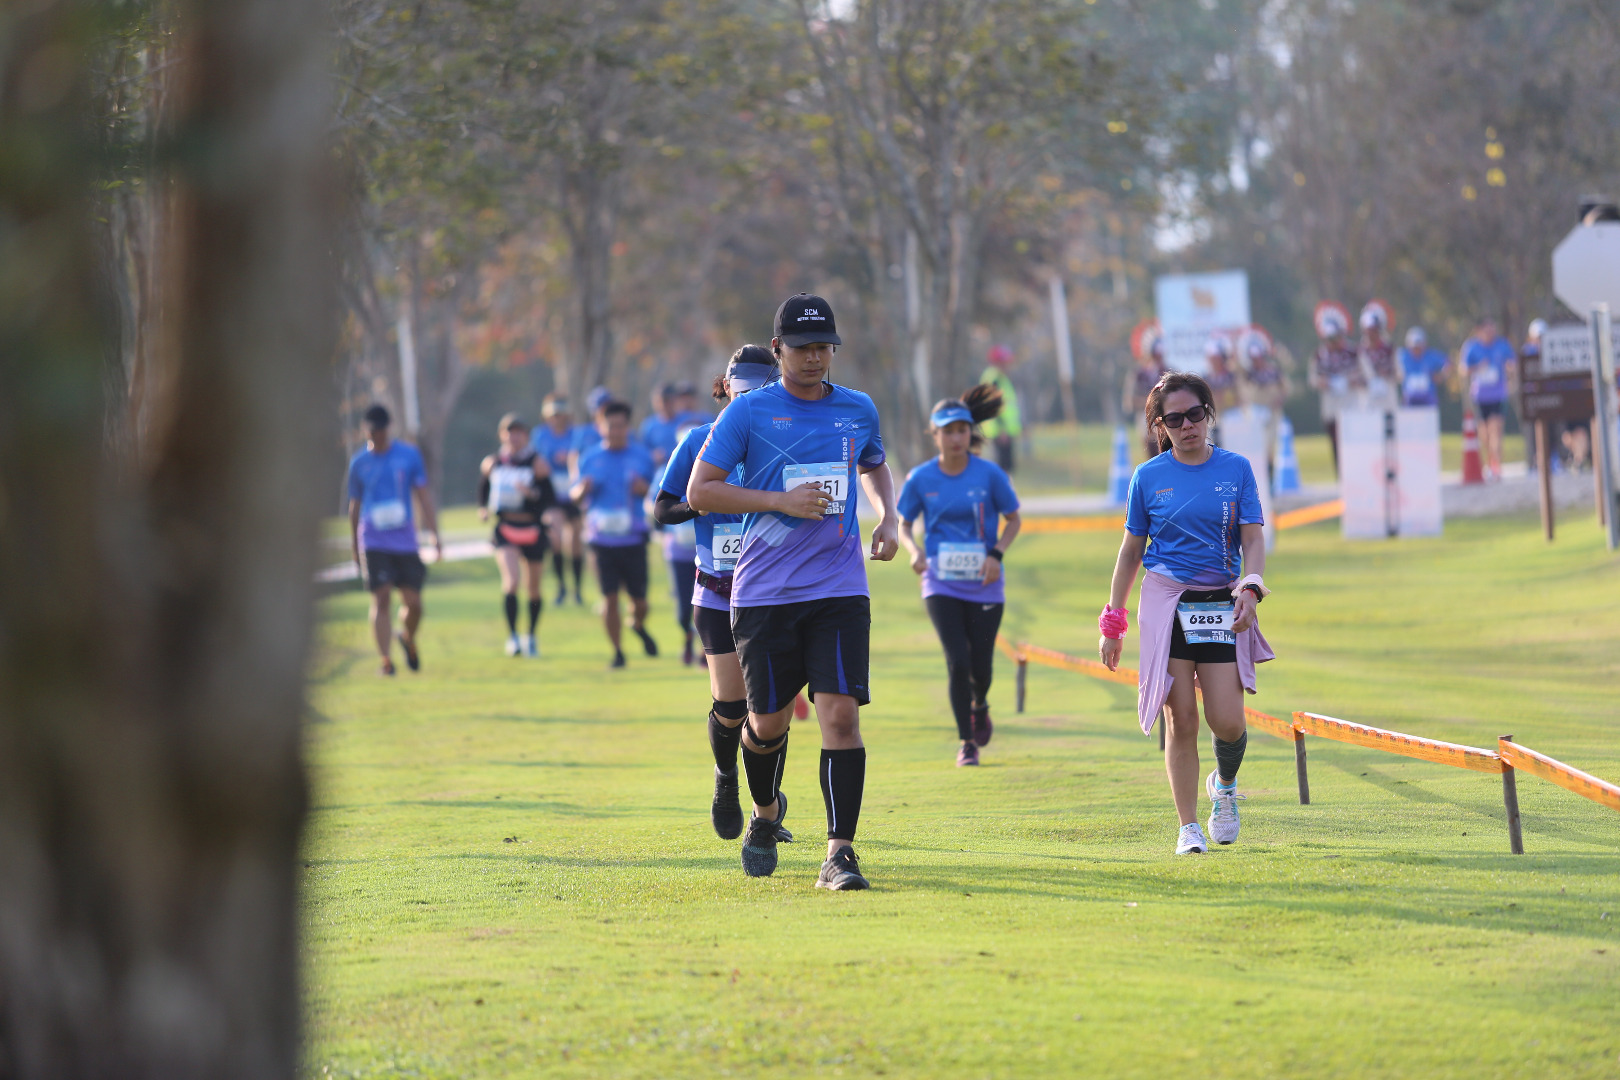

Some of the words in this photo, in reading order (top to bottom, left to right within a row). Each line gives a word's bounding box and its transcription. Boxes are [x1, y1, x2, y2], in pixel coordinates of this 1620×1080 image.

[804, 308, 819, 316] SCM
[805, 479, 839, 496] 51
[1228, 501, 1236, 530] SINGHA
[722, 538, 741, 554] 62
[946, 554, 979, 567] 6055
[1189, 614, 1223, 625] 6283
